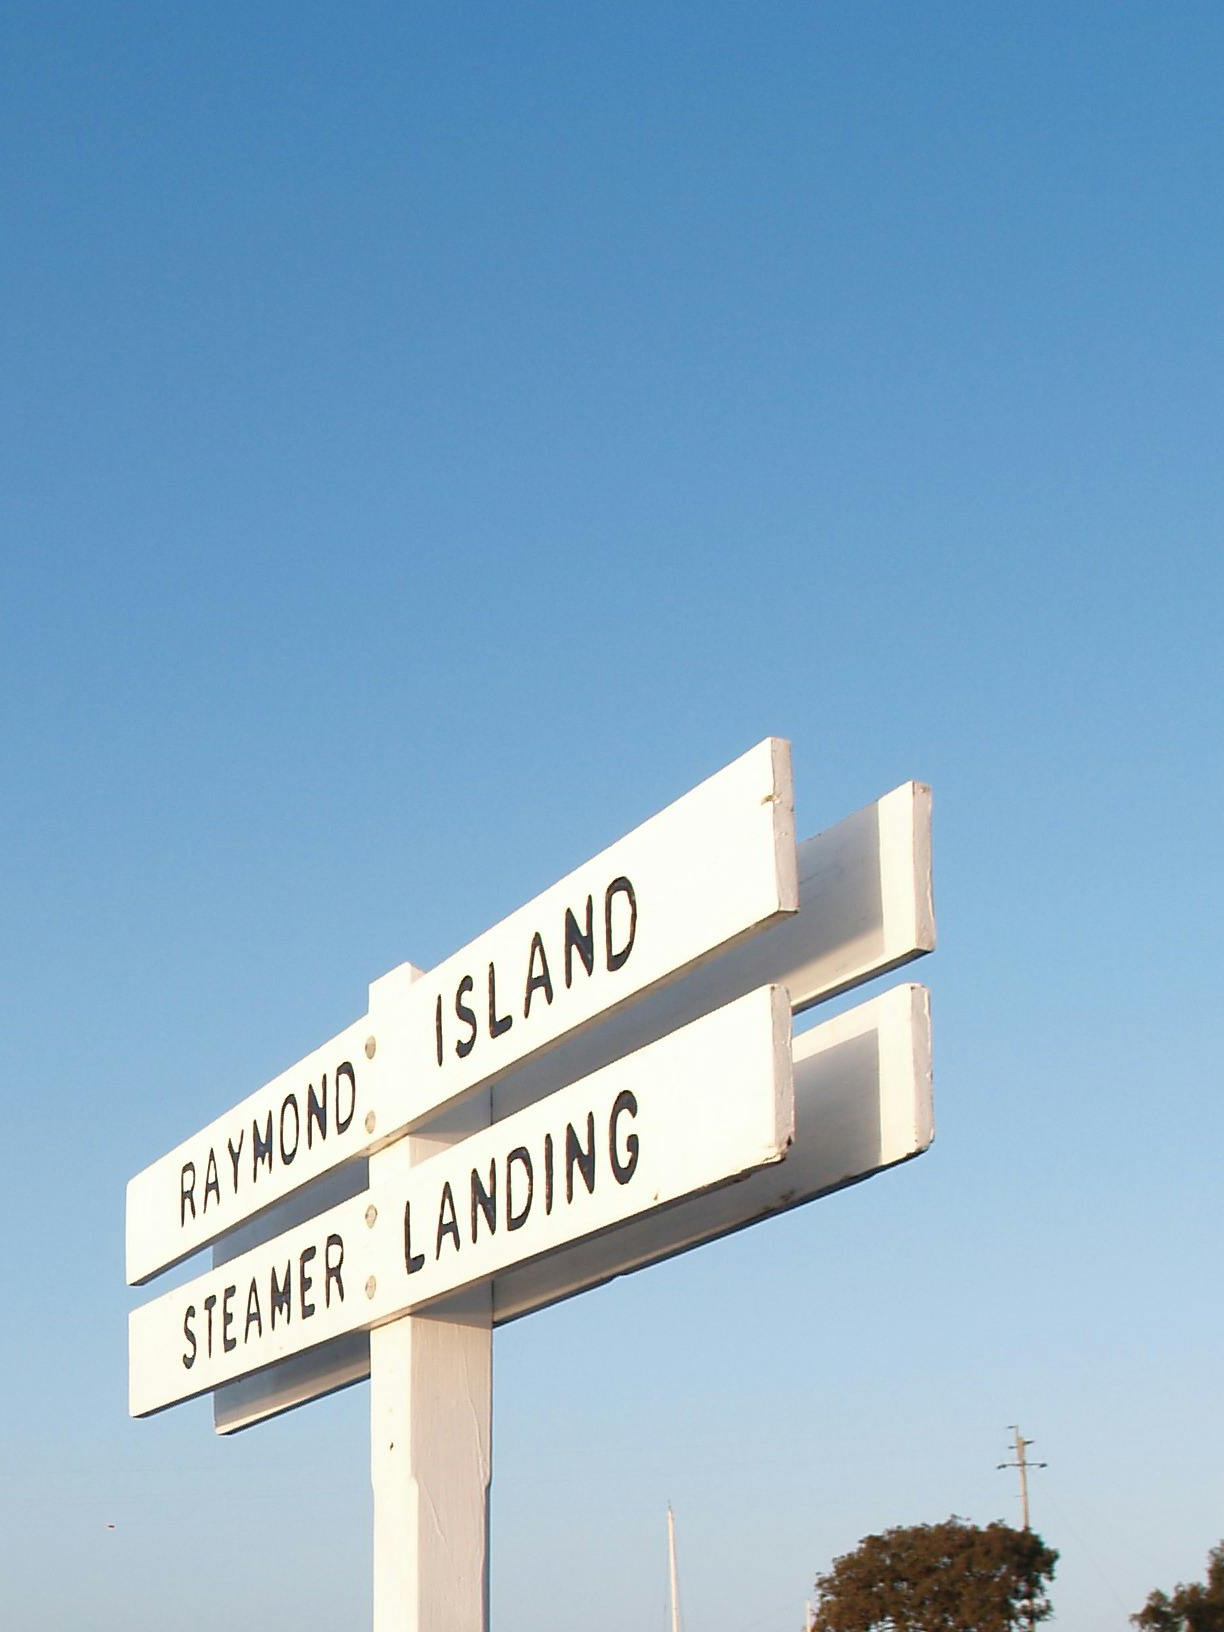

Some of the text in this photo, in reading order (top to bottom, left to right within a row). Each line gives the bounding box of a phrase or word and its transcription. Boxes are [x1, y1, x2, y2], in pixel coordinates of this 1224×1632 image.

[180, 875, 638, 1228] RAYMOND ISLAND
[182, 1089, 640, 1370] STEAMER LANDING
